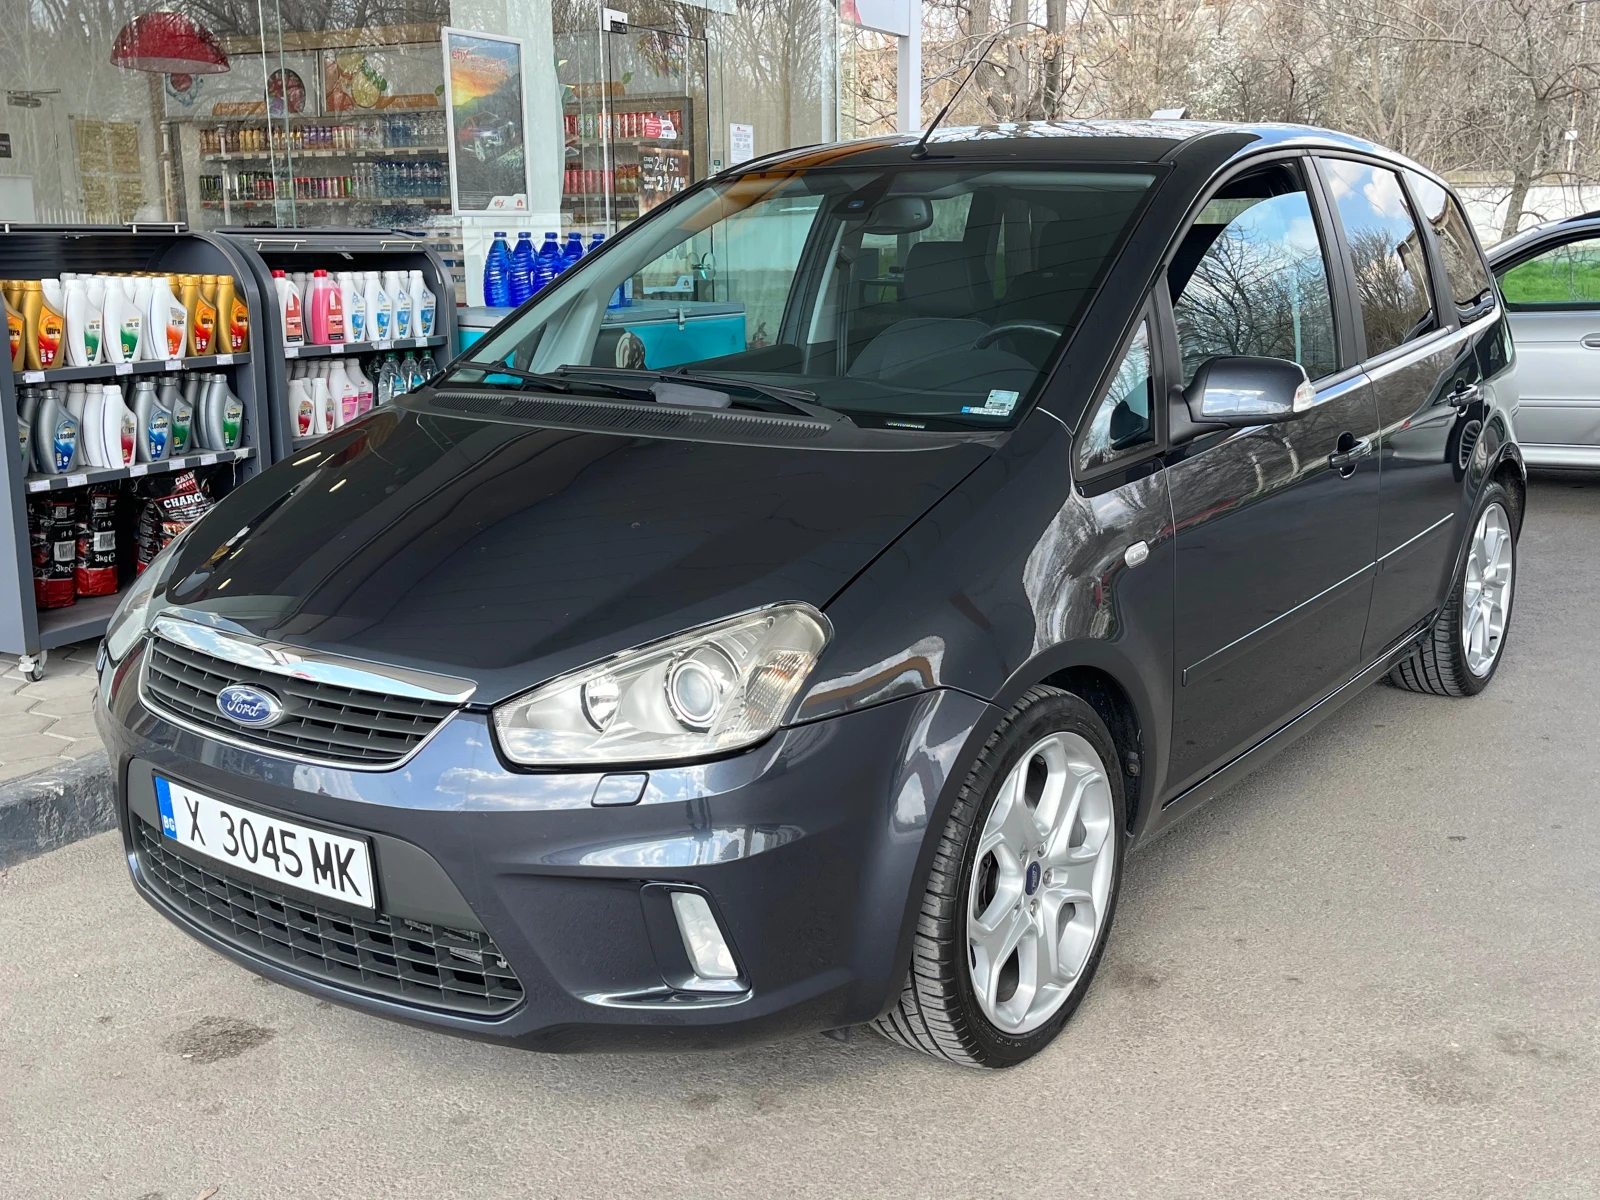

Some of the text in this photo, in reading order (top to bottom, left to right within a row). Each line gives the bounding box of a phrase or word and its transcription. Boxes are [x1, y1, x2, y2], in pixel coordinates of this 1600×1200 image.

[452, 48, 469, 63] efix
[151, 421, 168, 430] Leader
[57, 431, 76, 440] Leader
[227, 692, 261, 717] Ford
[163, 795, 363, 898] BG X 3045 MK
